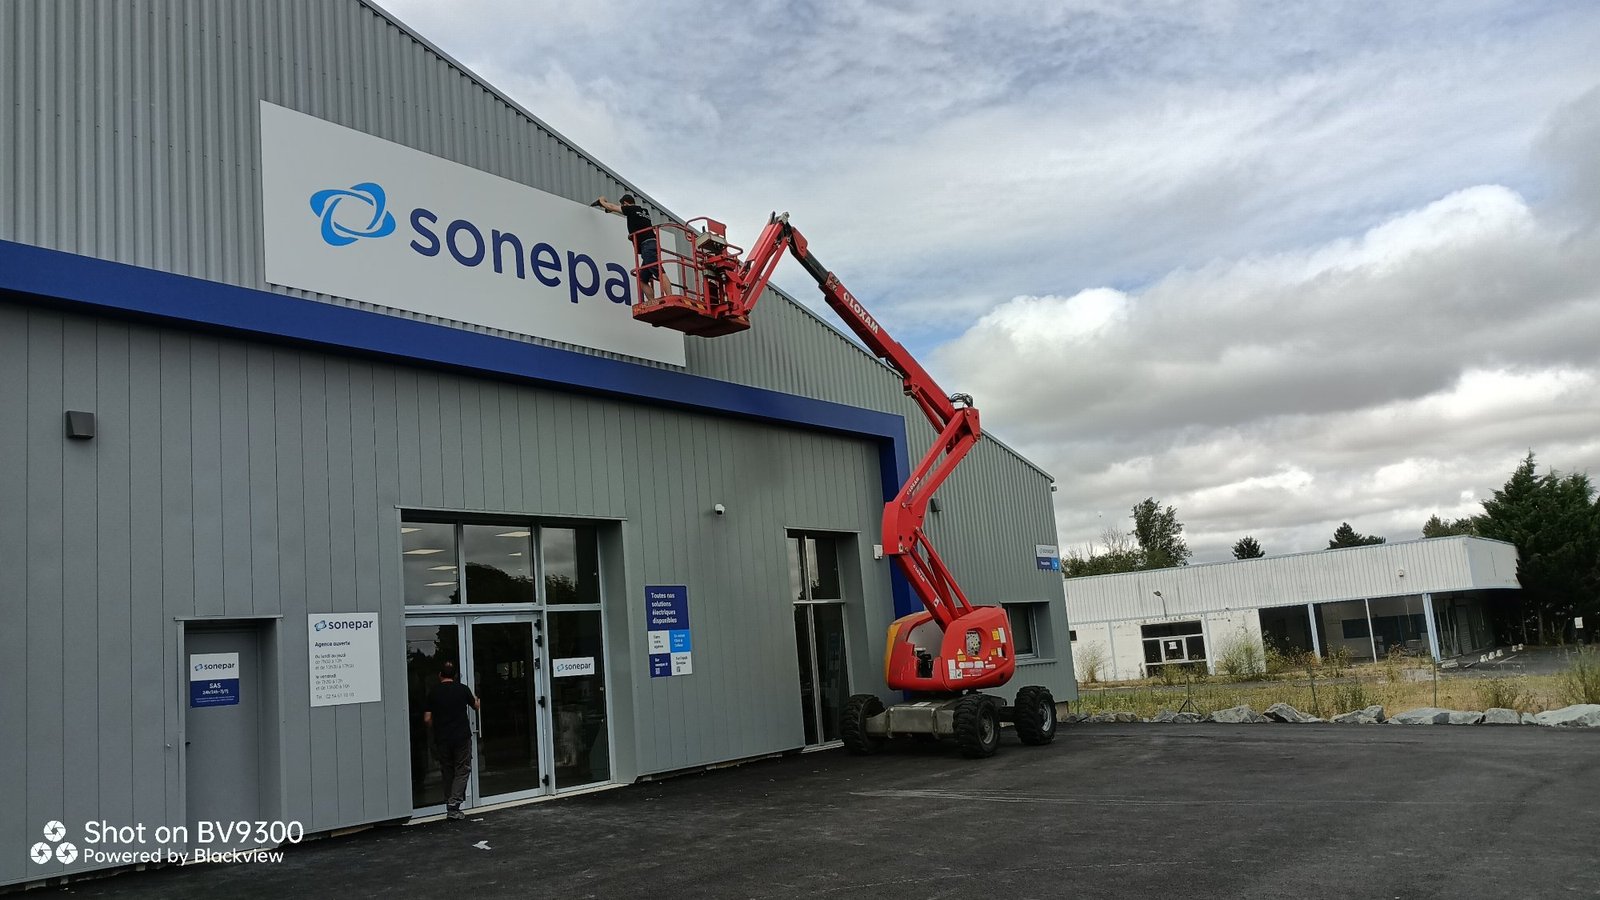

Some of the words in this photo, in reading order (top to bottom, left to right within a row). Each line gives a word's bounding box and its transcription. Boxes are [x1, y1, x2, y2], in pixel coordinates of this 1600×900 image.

[410, 207, 645, 306] sonepa
[849, 298, 879, 335] LOXAM
[329, 620, 373, 630] sonepar
